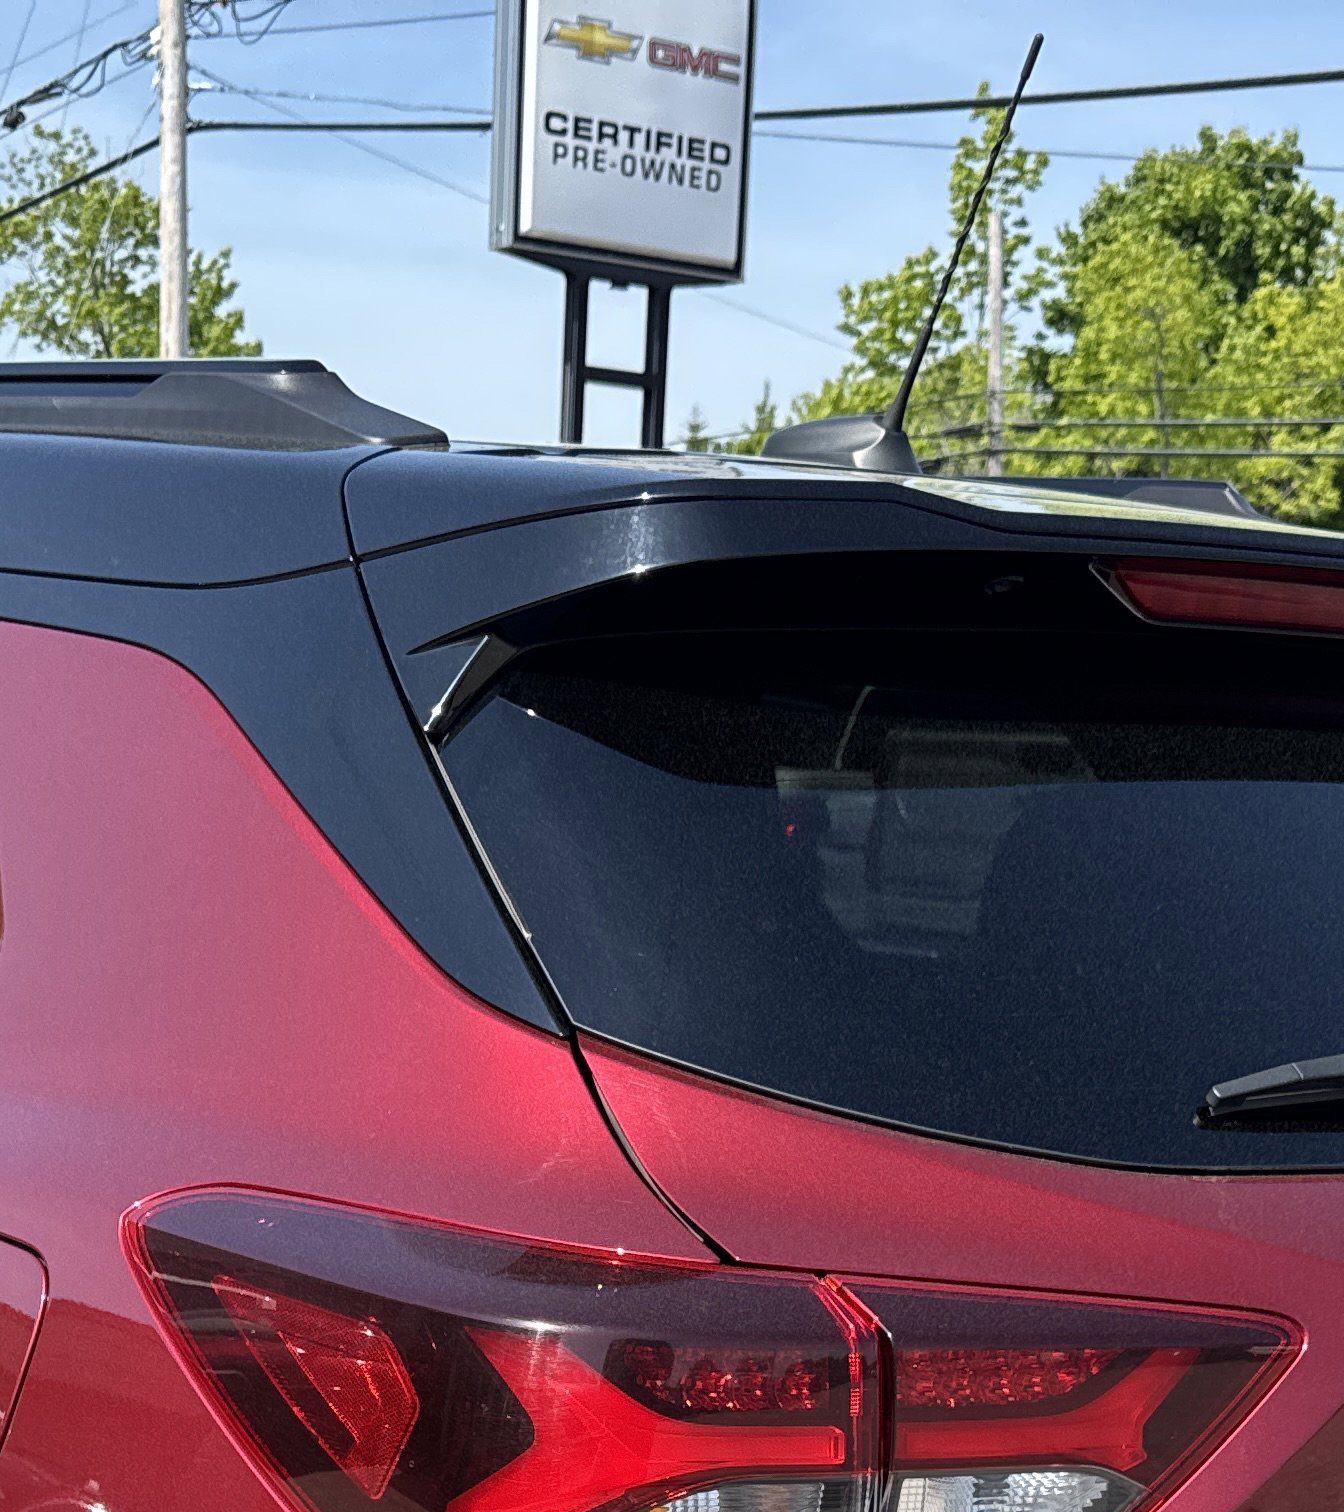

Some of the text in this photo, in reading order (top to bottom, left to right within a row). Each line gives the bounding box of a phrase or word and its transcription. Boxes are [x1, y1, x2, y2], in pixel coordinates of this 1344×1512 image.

[647, 36, 742, 86] GMC
[544, 110, 731, 167] CERTIFIED
[552, 142, 723, 193] PRE-OWNED
